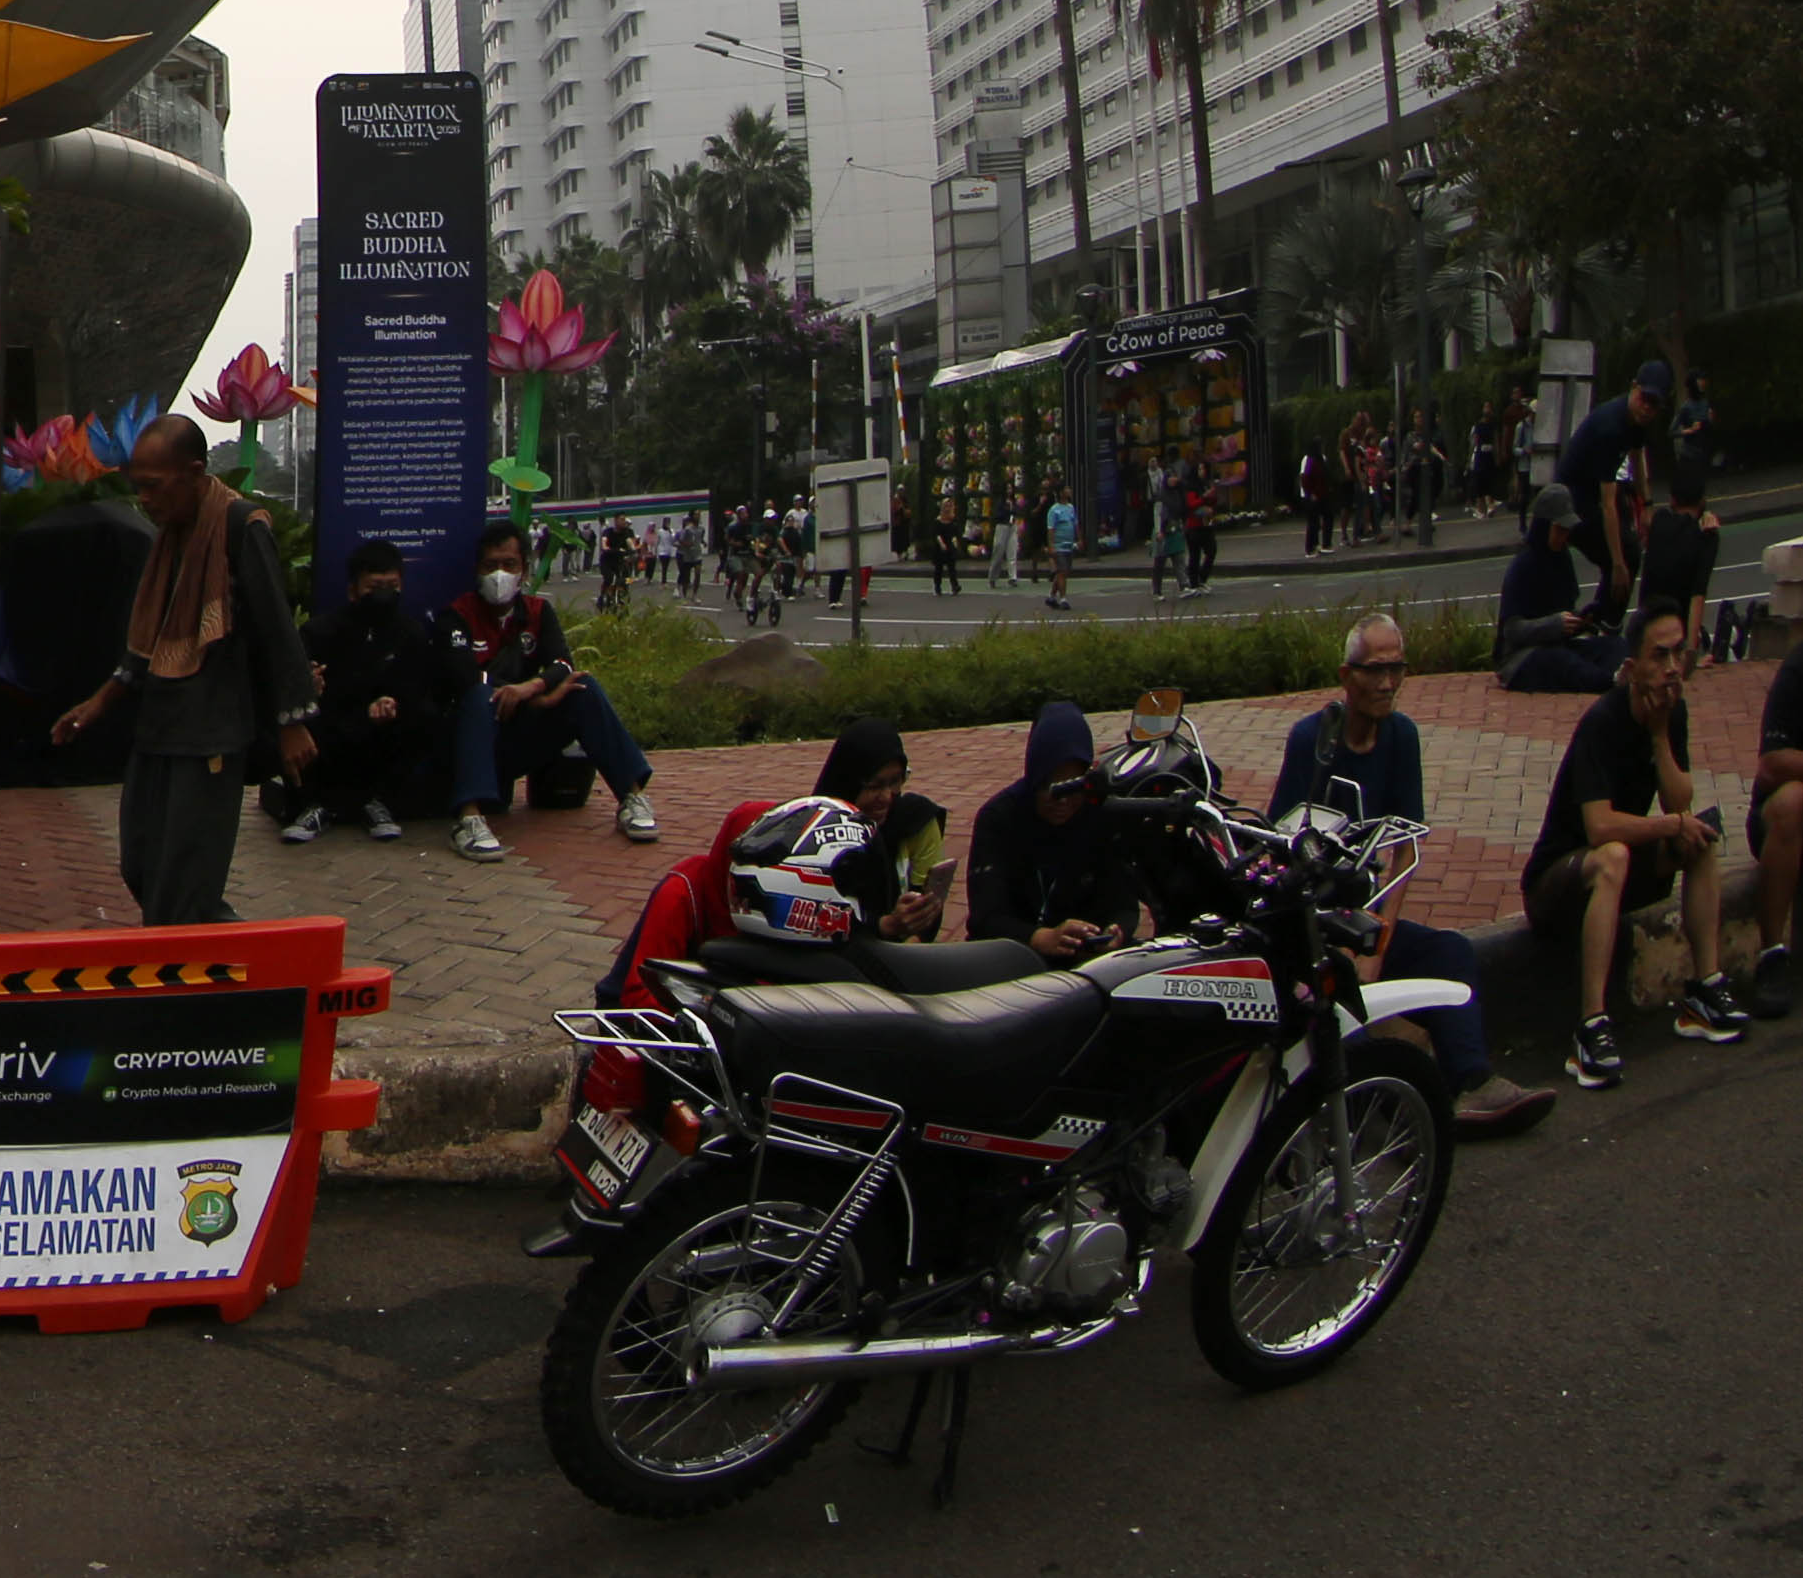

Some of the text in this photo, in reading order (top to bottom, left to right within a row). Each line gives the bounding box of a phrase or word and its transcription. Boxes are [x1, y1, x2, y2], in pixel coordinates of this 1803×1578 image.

[341, 103, 462, 126] ILLUMINATION
[363, 123, 439, 140] JAKARTA
[436, 125, 460, 134] 2026
[365, 211, 444, 230] SACRED
[363, 236, 446, 255] BUDDHA
[340, 260, 470, 281] ILLUMINATION
[365, 314, 446, 326] Sacred Buddha
[375, 329, 437, 340] Illumination
[1106, 323, 1225, 353] Glow of Peace
[435, 364, 462, 372] Buddha
[814, 826, 866, 845] X-ONE
[793, 898, 816, 915] BIG
[785, 913, 816, 933] BULL
[1164, 979, 1258, 999] HONDA
[317, 986, 378, 1016] MIG
[113, 1047, 266, 1070] CRYPTOWAVE
[121, 1086, 160, 1101] Crypto
[162, 1084, 197, 1097] Media
[199, 1083, 223, 1095] and
[225, 1081, 277, 1095] Research
[939, 1131, 970, 1143] WIN
[182, 1162, 237, 1174] METRO JAYA
